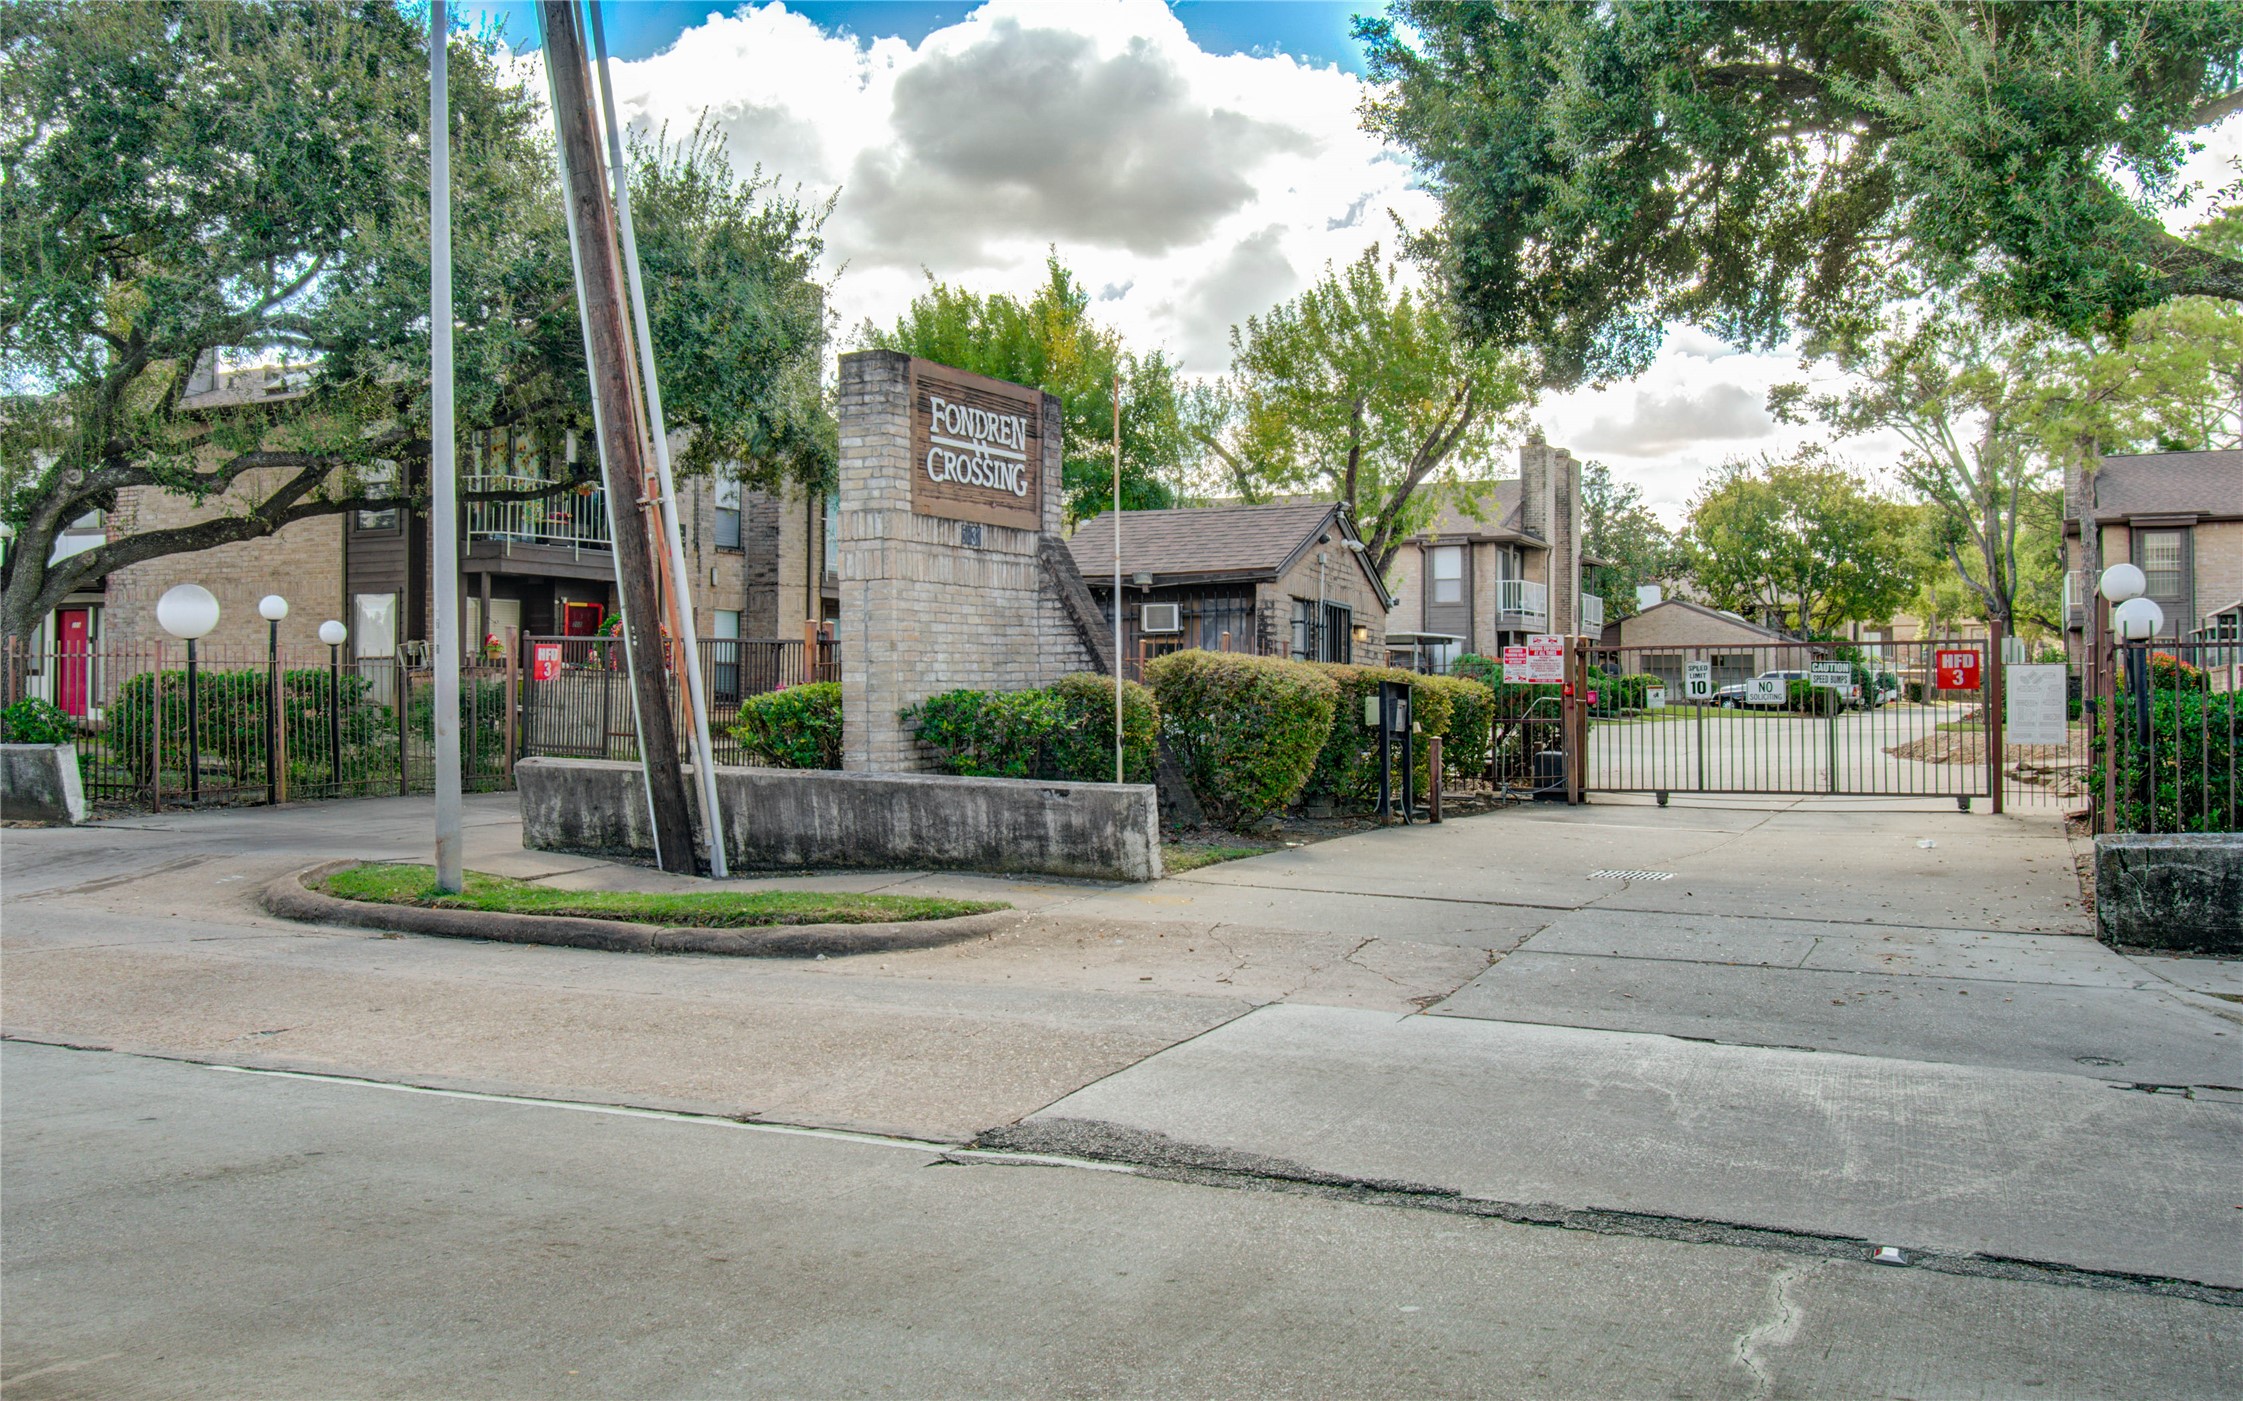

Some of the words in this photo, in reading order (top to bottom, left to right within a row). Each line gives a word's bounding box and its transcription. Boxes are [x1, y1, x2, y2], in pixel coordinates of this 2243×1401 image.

[930, 396, 1027, 451] FONDREN
[927, 447, 1028, 497] CROSSING
[538, 647, 558, 661] HFD
[1942, 653, 1974, 668] HFD
[543, 661, 552, 677] 3
[1812, 662, 1848, 673] CAUTION
[1813, 674, 1829, 684] SPEED
[1830, 674, 1848, 684] BUMPS
[1952, 669, 1964, 686] 3
[1690, 680, 1706, 694] 10
[1758, 681, 1773, 693] NO
[1750, 692, 1782, 701] SOLICITING
